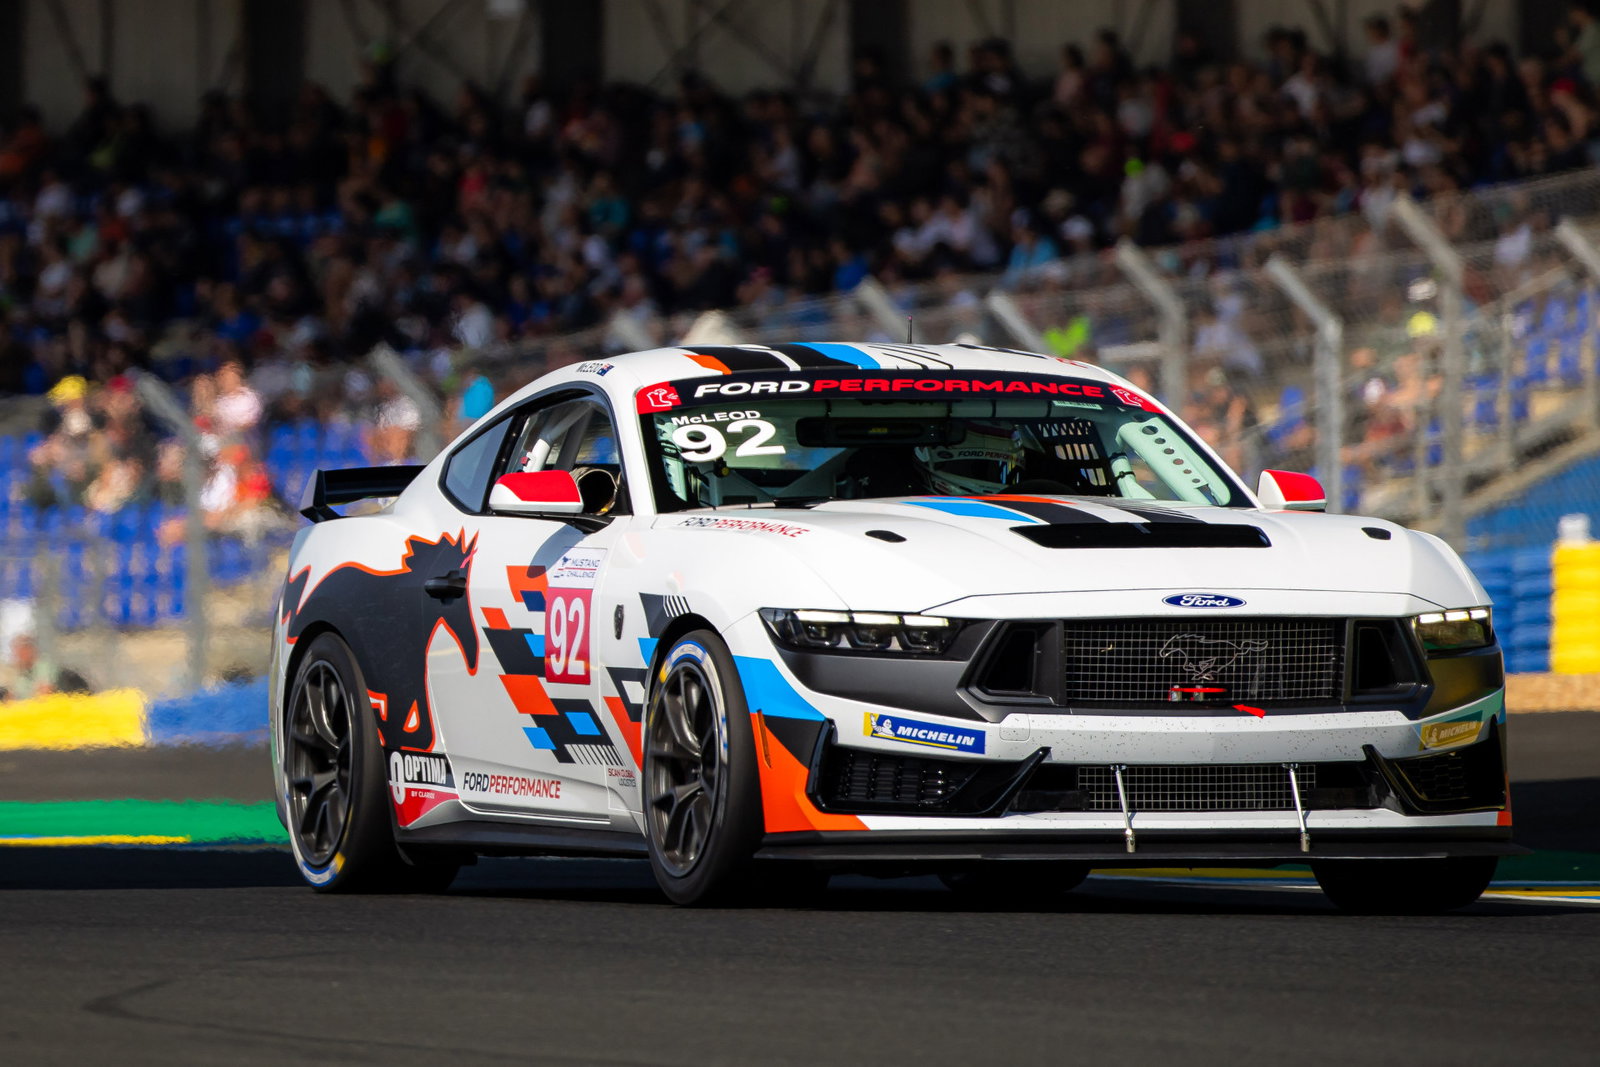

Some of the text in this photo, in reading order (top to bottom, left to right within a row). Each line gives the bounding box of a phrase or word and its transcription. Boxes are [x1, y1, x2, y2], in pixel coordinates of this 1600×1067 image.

[671, 410, 761, 426] McLEOD
[672, 419, 786, 463] 92
[958, 450, 984, 458] FORD
[1180, 594, 1230, 607] Ford
[550, 596, 586, 676] 92
[896, 725, 976, 747] MICHELIN
[404, 754, 446, 785] OPTIMA
